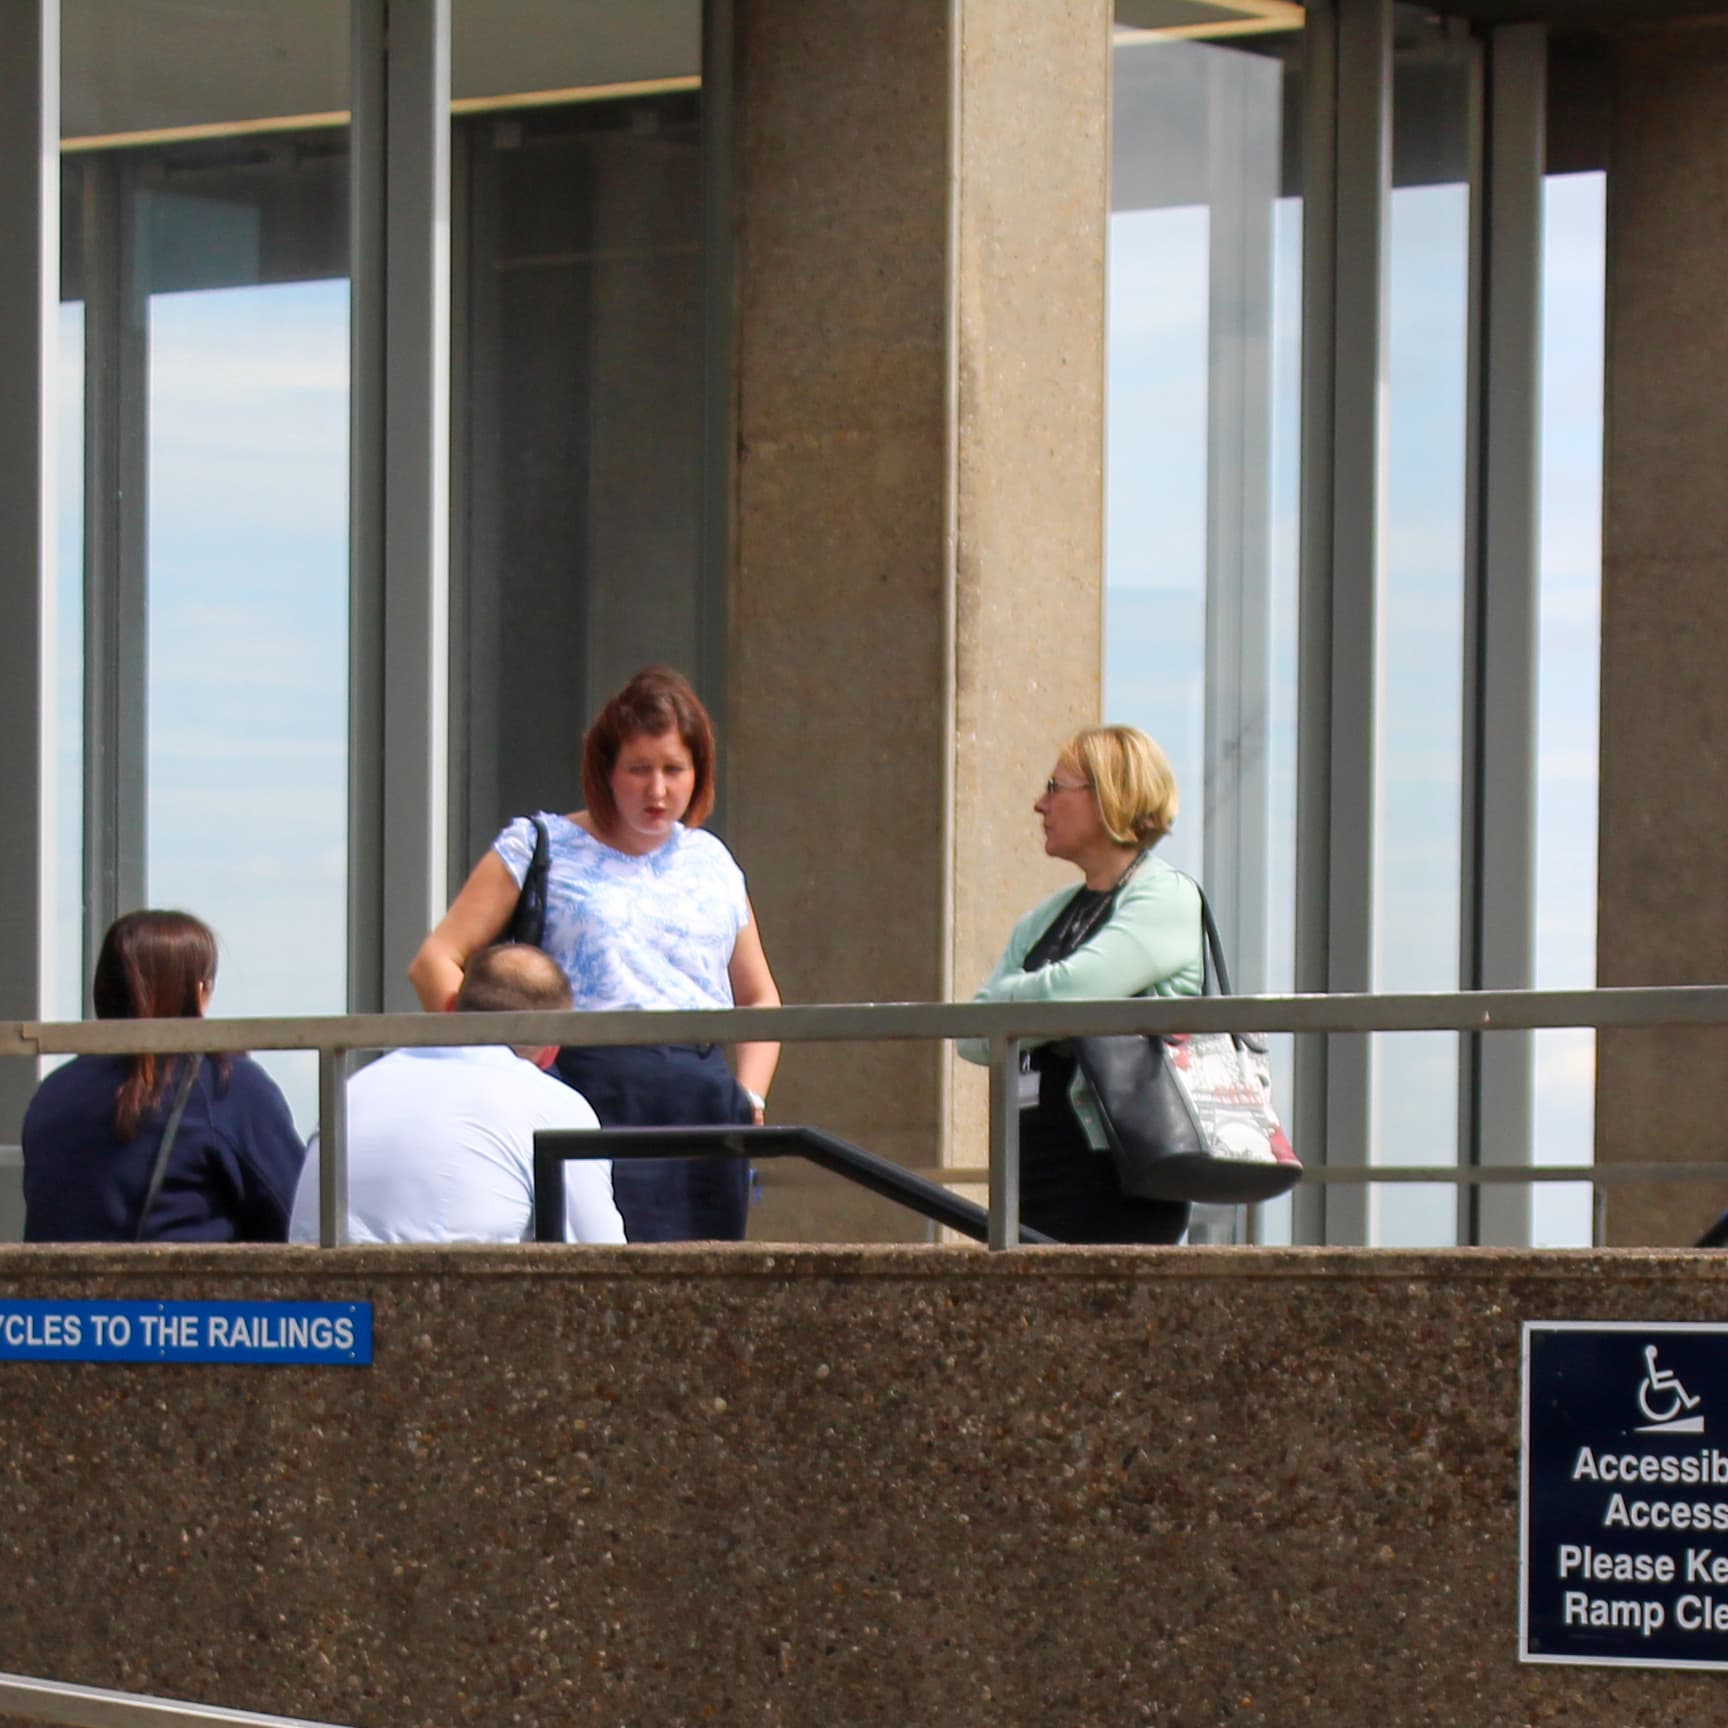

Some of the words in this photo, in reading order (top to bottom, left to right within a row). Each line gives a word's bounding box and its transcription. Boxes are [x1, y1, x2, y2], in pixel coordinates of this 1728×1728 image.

[91, 1315, 130, 1346] TO
[139, 1316, 199, 1347] THE
[209, 1317, 354, 1348] RAILINGS
[1560, 1545, 1675, 1581] Please
[1565, 1592, 1665, 1635] Ramp
